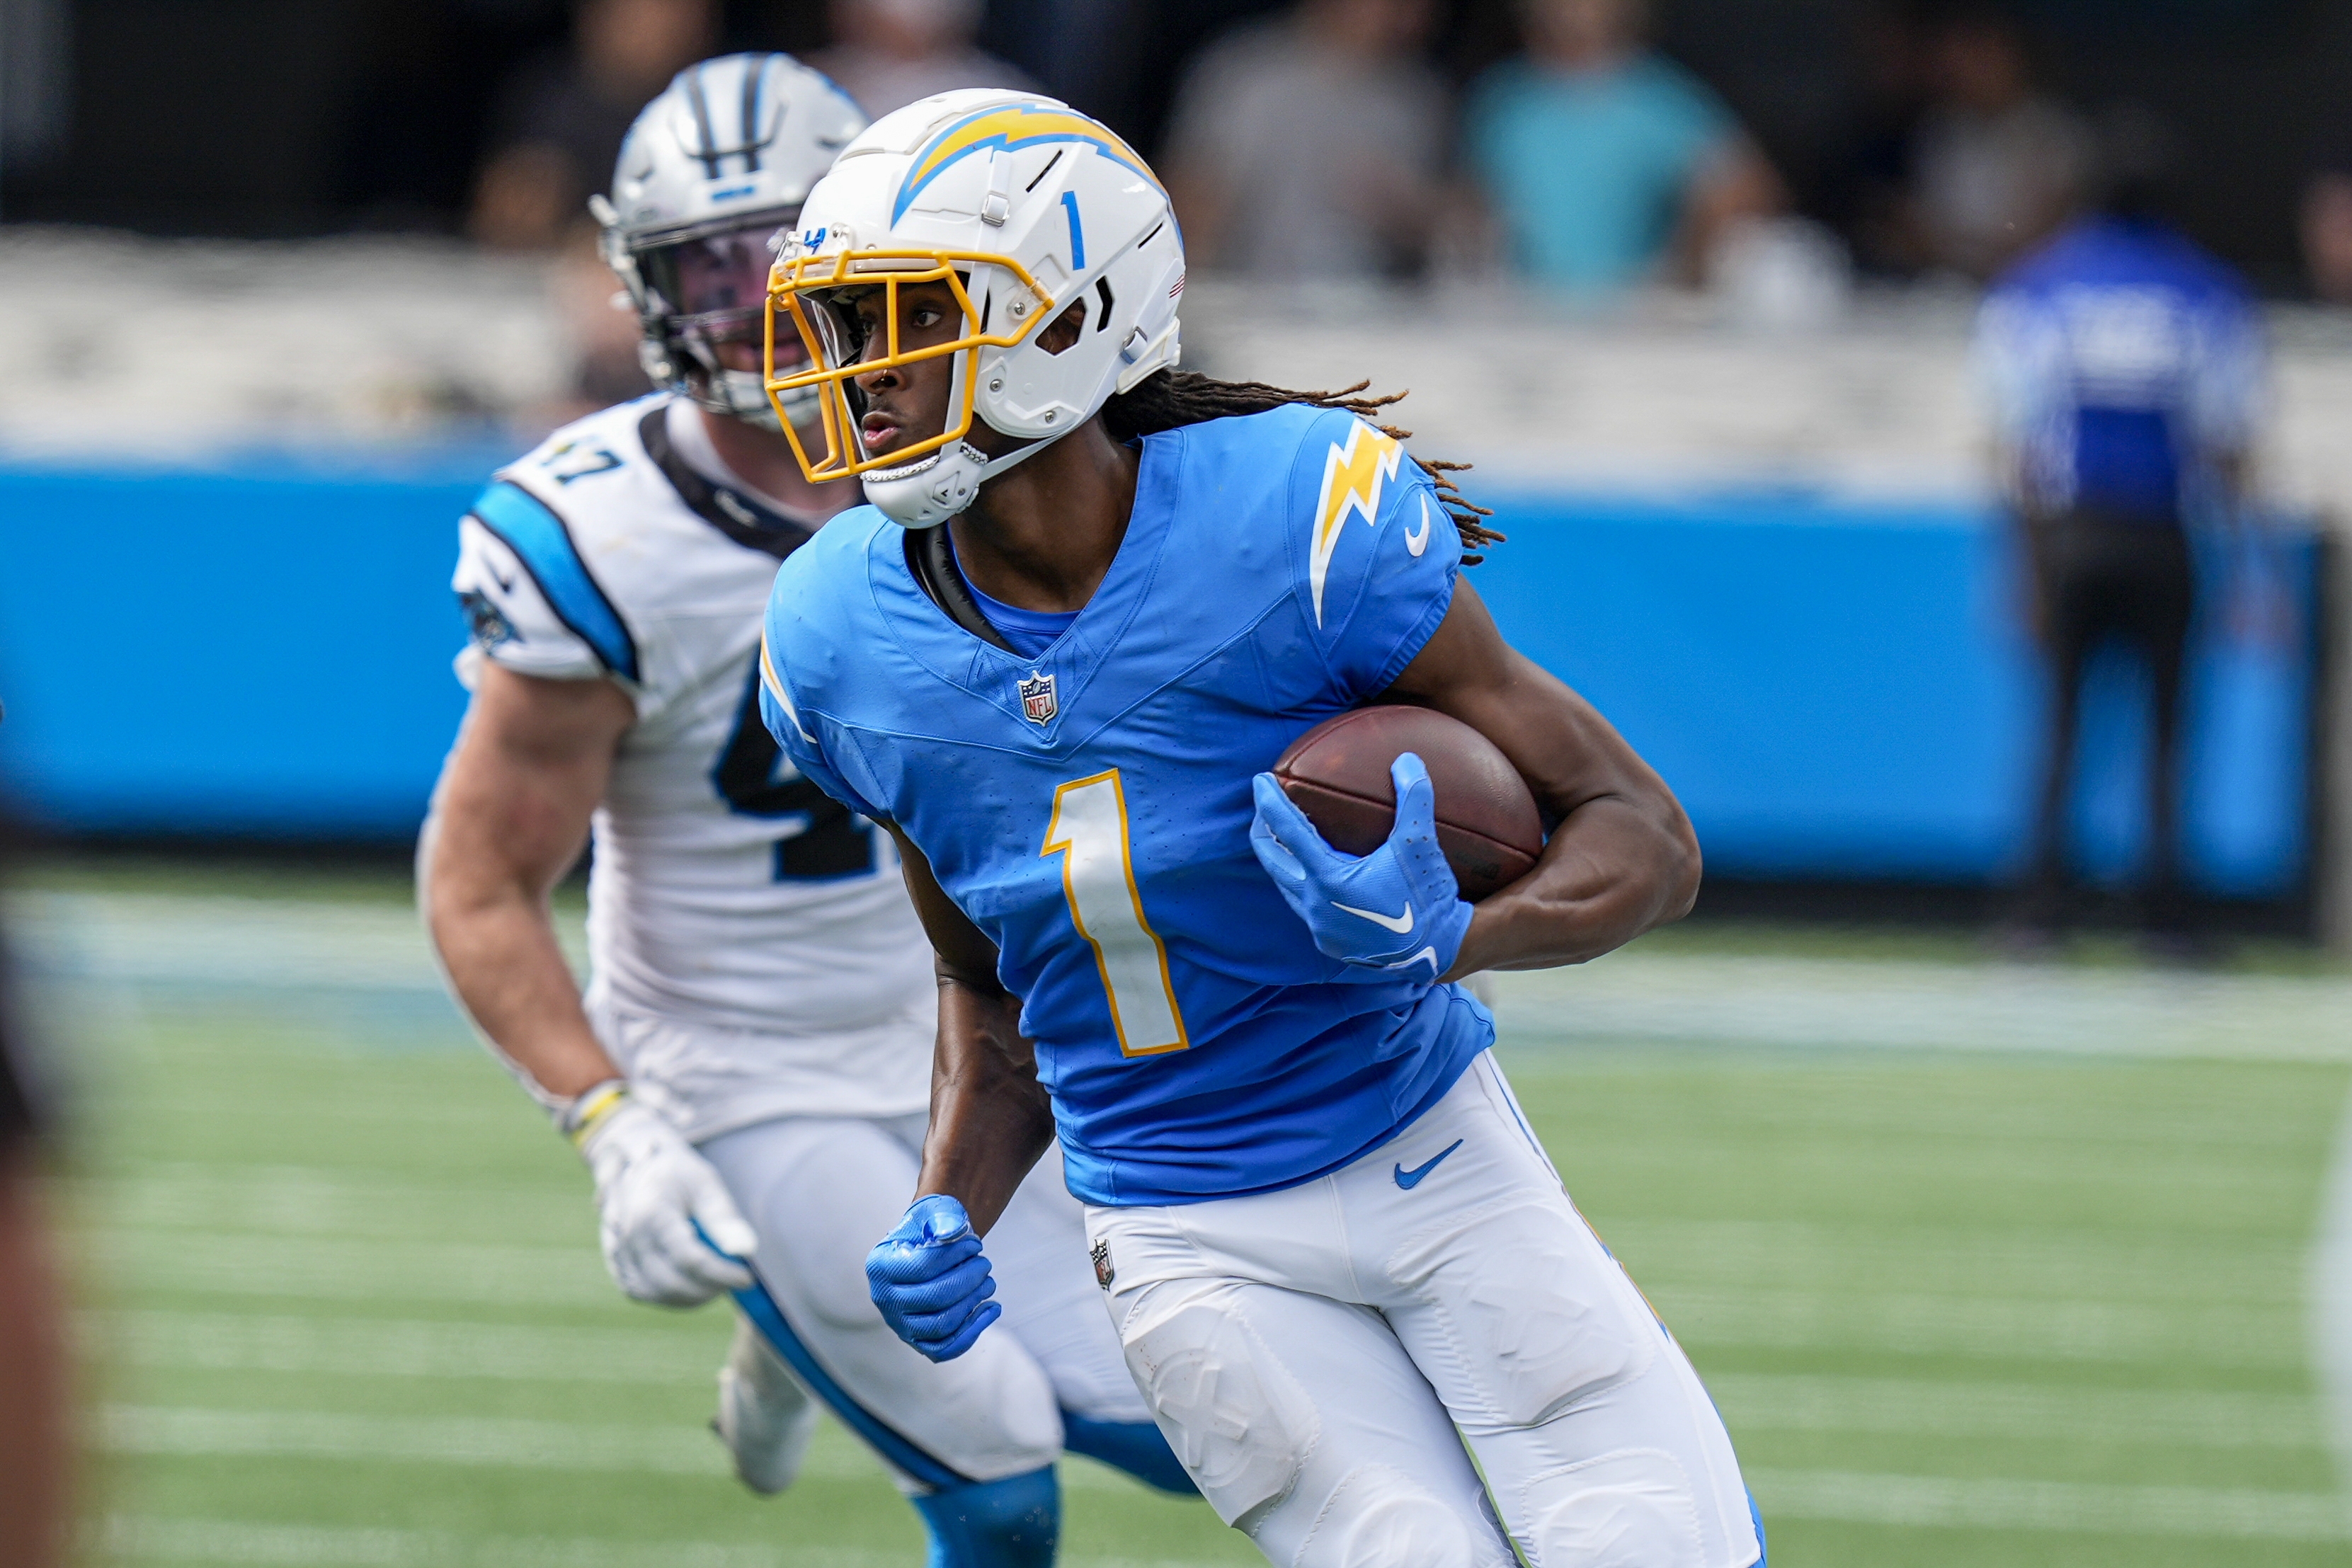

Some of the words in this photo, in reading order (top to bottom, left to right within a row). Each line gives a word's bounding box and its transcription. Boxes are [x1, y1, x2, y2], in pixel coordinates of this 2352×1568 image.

[1061, 191, 1085, 270] 1
[710, 639, 901, 883] 4
[1026, 696, 1051, 716] NFL
[1040, 767, 1189, 1058] 1
